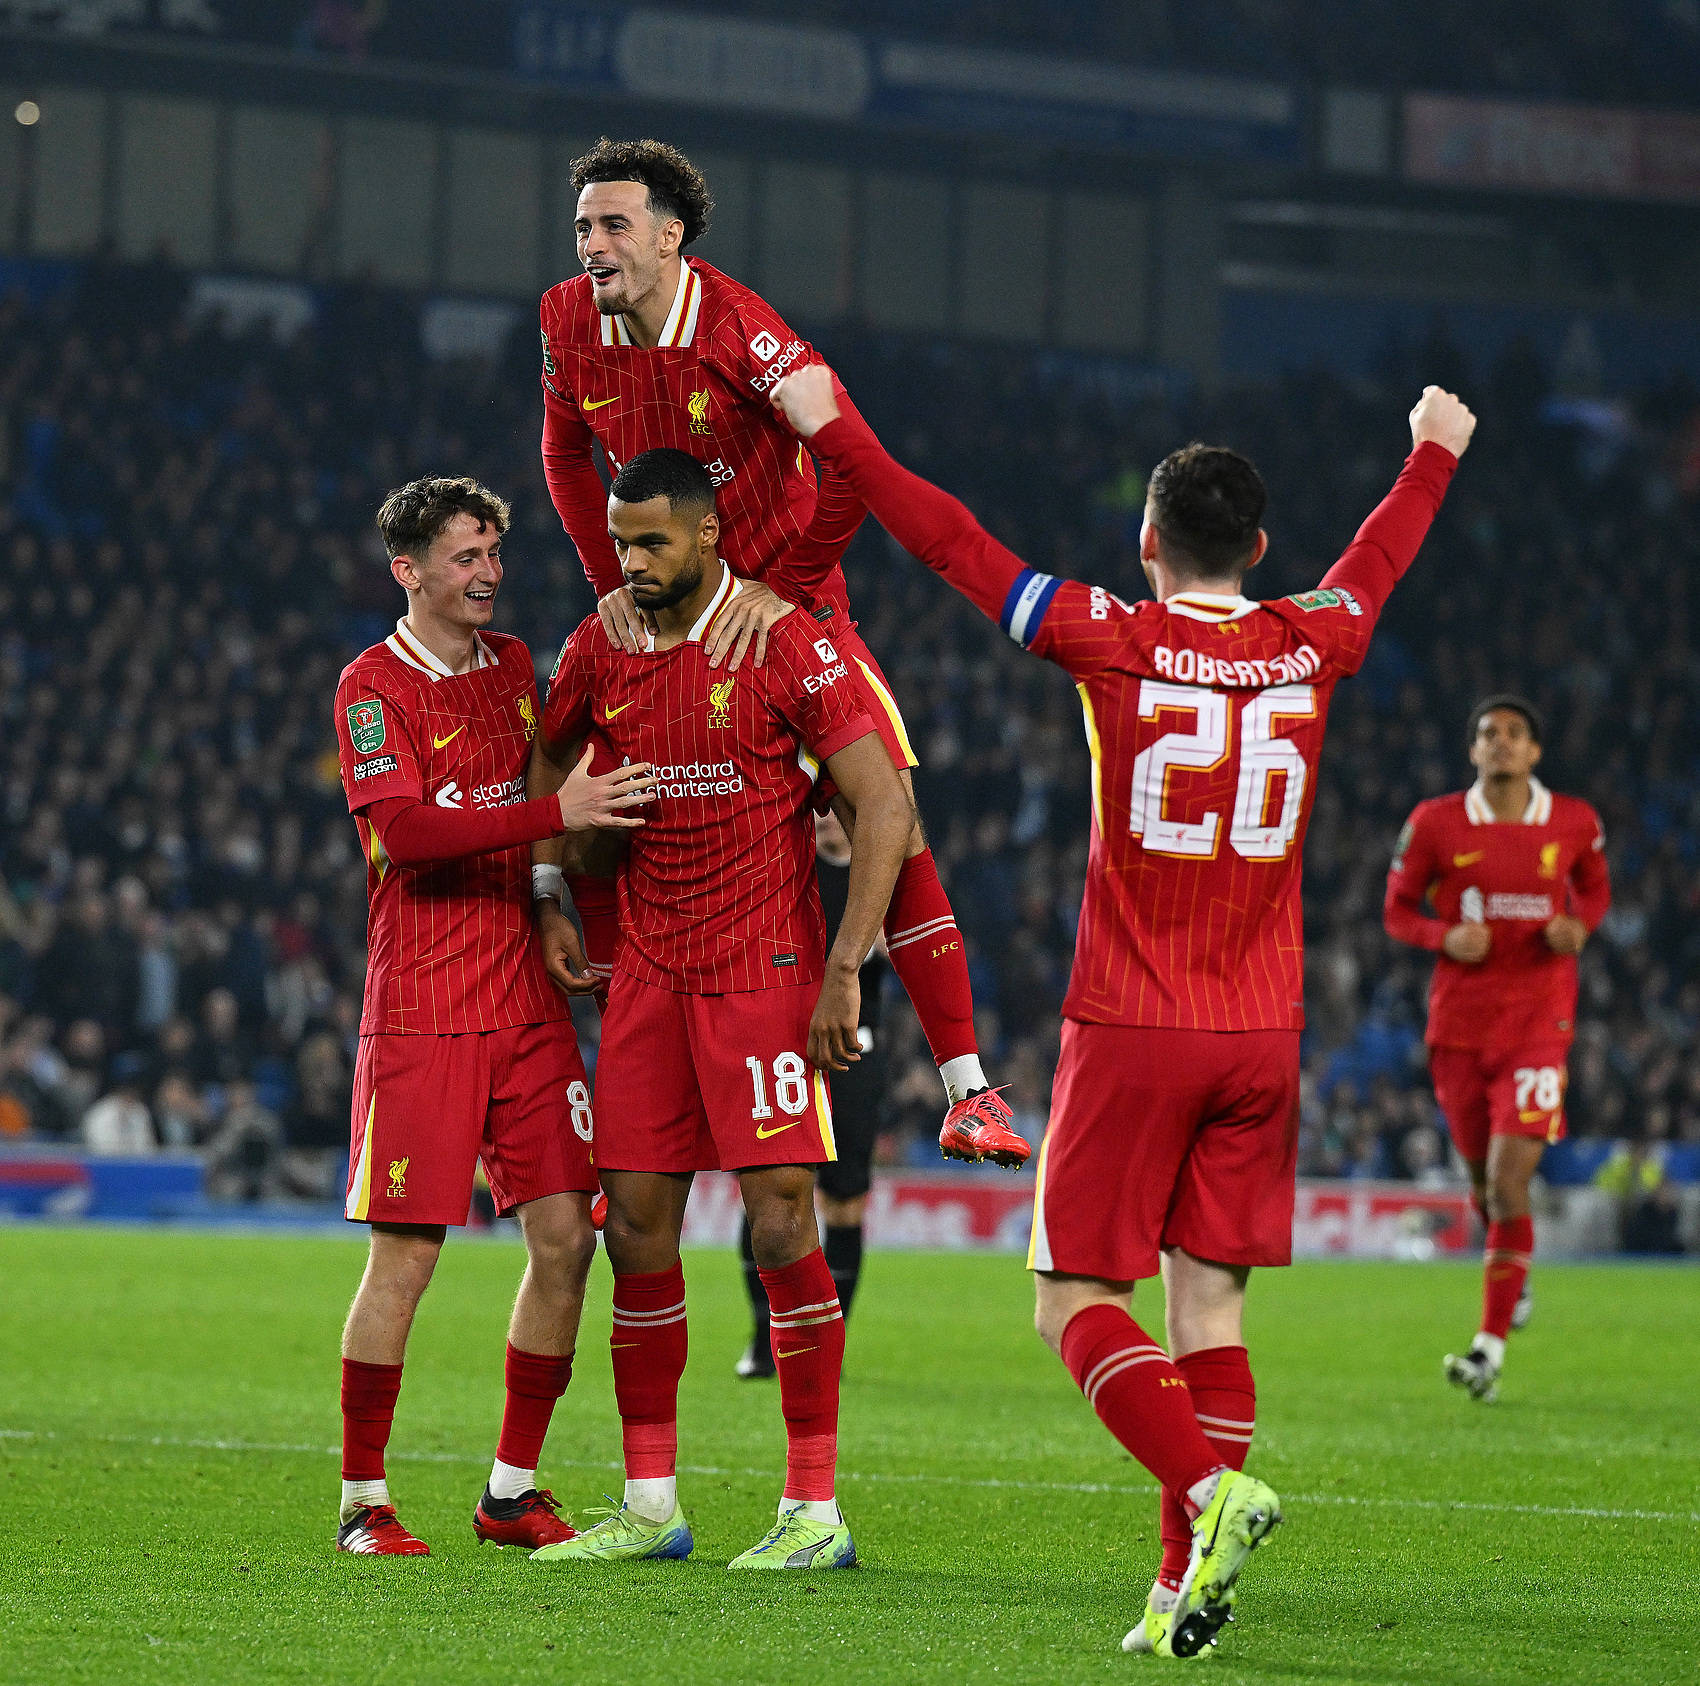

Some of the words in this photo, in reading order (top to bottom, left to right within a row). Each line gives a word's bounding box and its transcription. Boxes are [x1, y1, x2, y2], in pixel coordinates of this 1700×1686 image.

[750, 340, 806, 392] Expedia
[360, 729, 374, 740] Cup
[353, 763, 367, 773] No
[366, 756, 392, 768] room
[354, 770, 367, 782] for
[367, 763, 398, 777] racism
[1129, 679, 1318, 862] 26
[931, 941, 959, 959] LFC
[745, 1051, 810, 1121] 18
[1513, 1066, 1560, 1111] 78
[566, 1080, 594, 1144] 8
